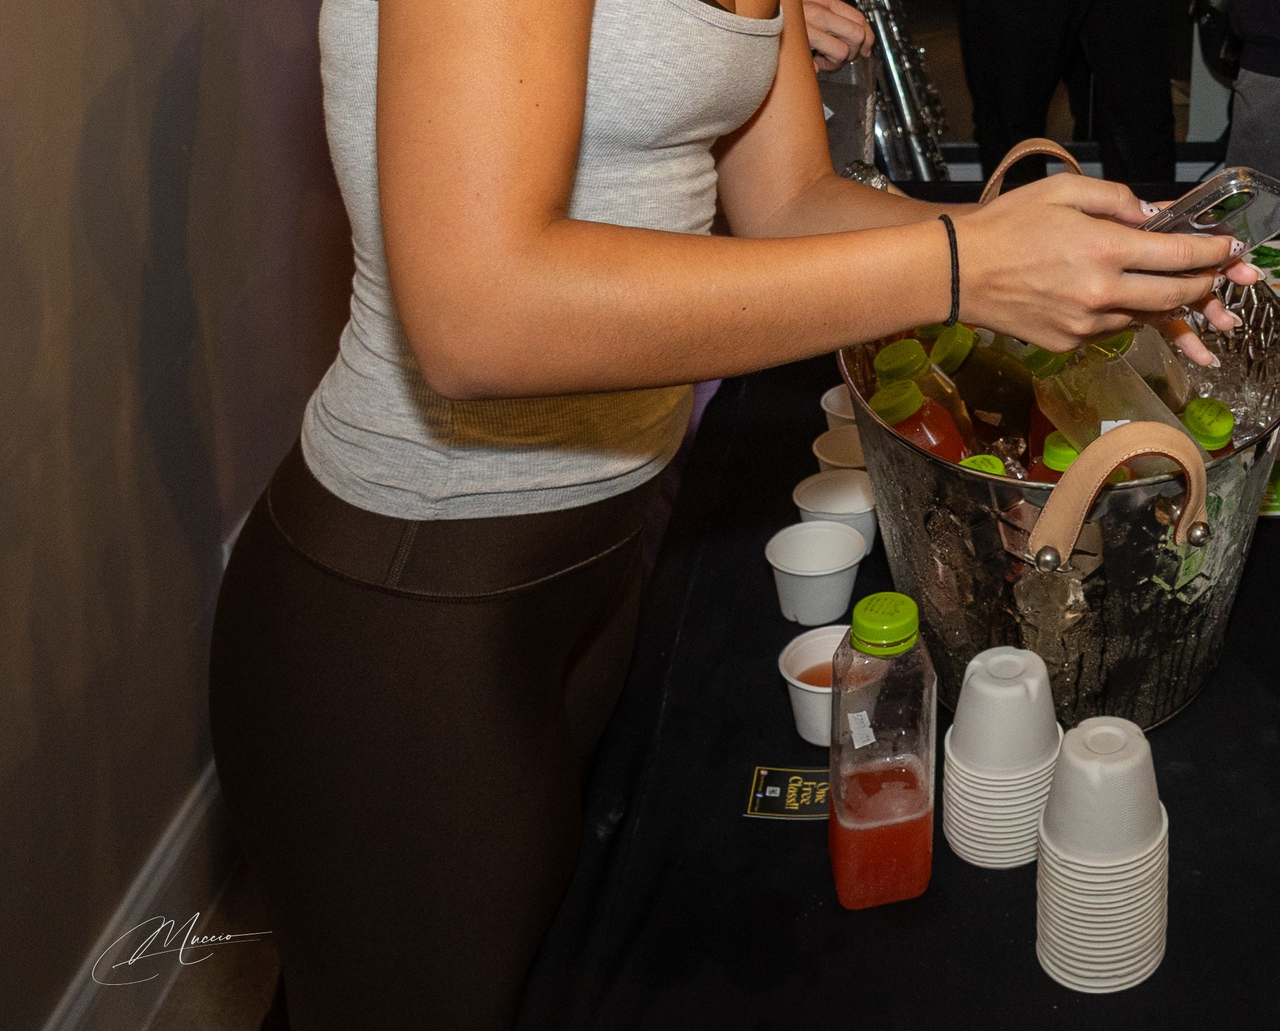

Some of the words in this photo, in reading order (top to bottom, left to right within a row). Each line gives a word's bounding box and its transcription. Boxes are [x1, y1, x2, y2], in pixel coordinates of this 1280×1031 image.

[785, 775, 803, 810] Class!!
[800, 781, 817, 805] Free
[815, 781, 829, 804] One
